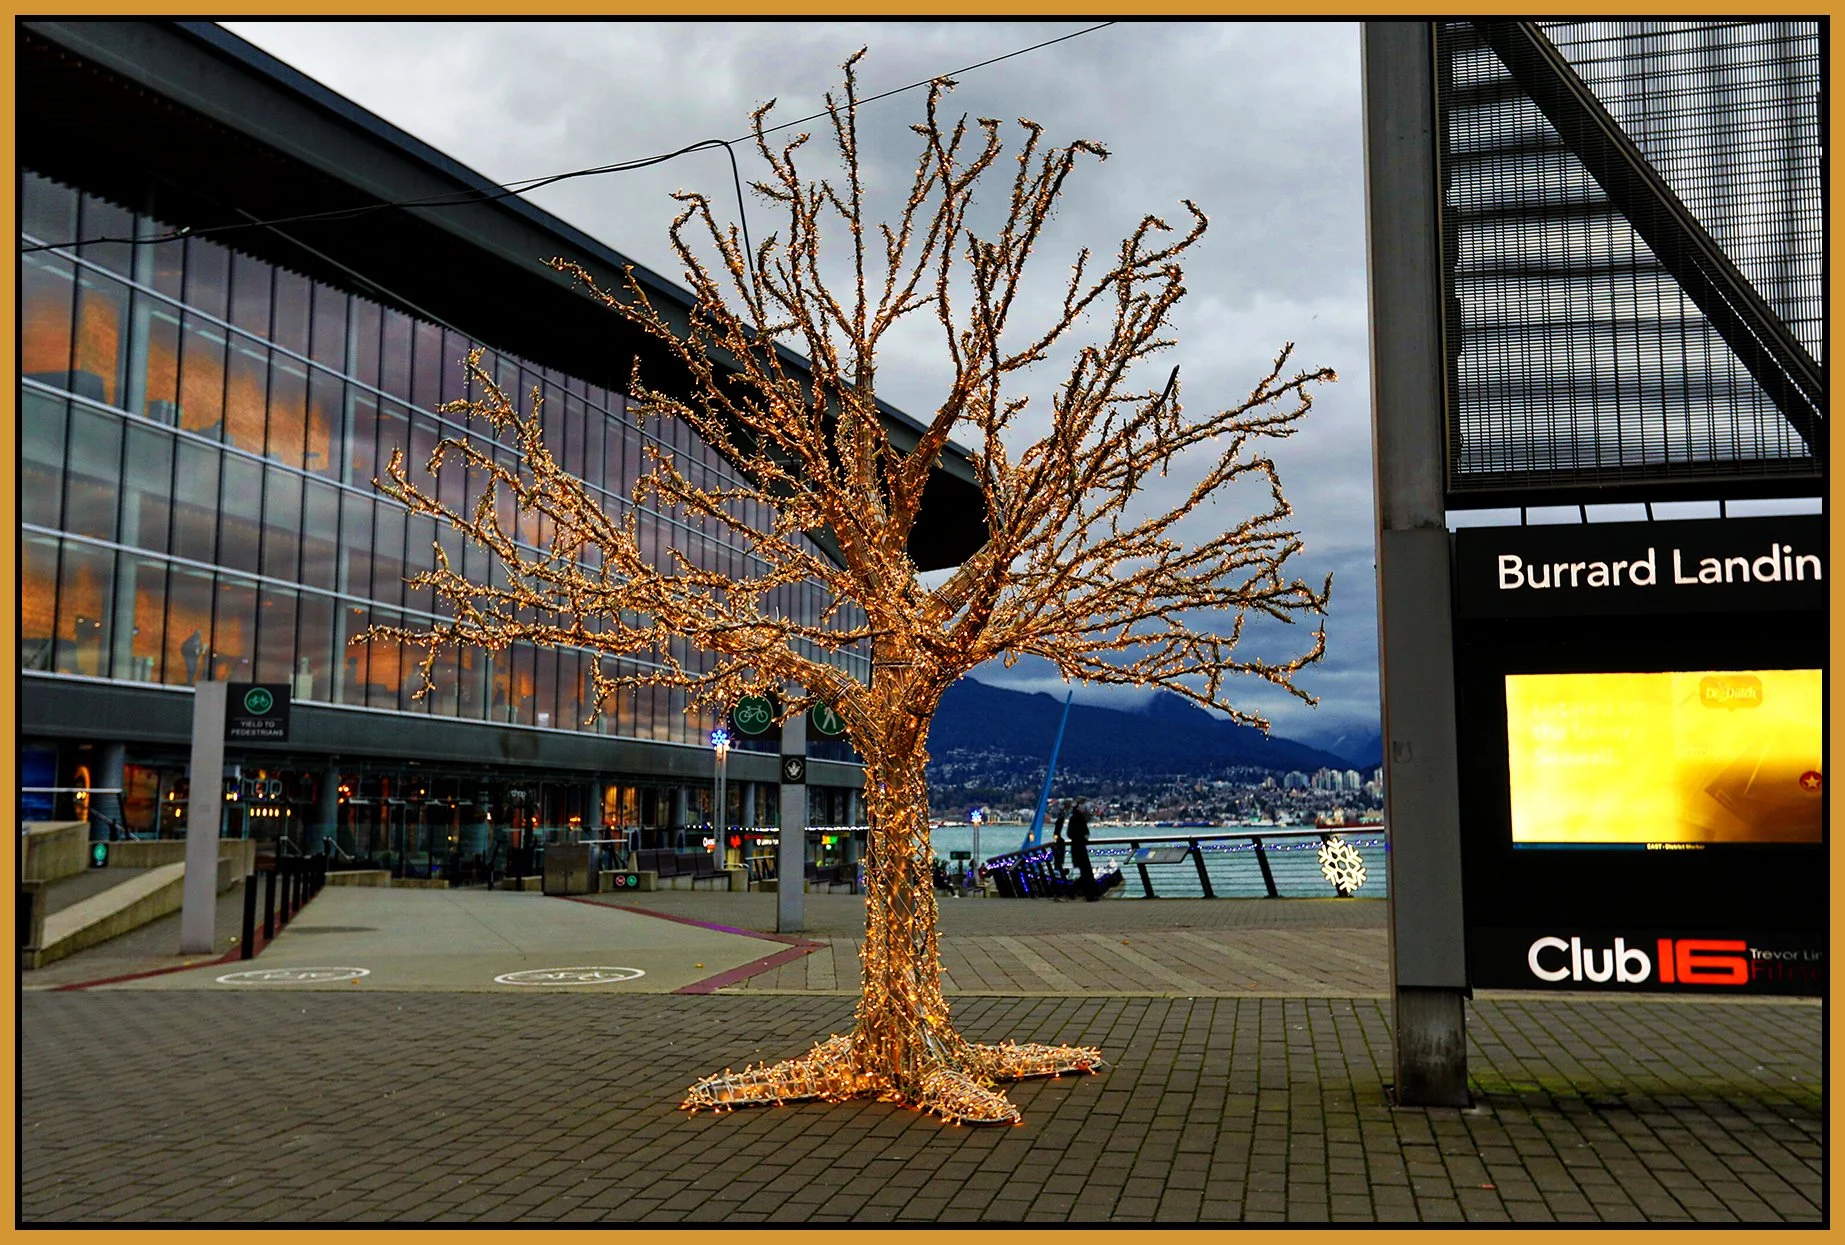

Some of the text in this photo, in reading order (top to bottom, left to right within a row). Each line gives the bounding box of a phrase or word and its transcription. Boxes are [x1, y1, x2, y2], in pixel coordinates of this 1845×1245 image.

[1498, 543, 1822, 590] Burrard Landin
[240, 720, 263, 728] YIELD
[231, 728, 284, 737] PEDESTRIANS
[1528, 936, 1749, 985] Club 16
[1749, 948, 1799, 961] Trevor
